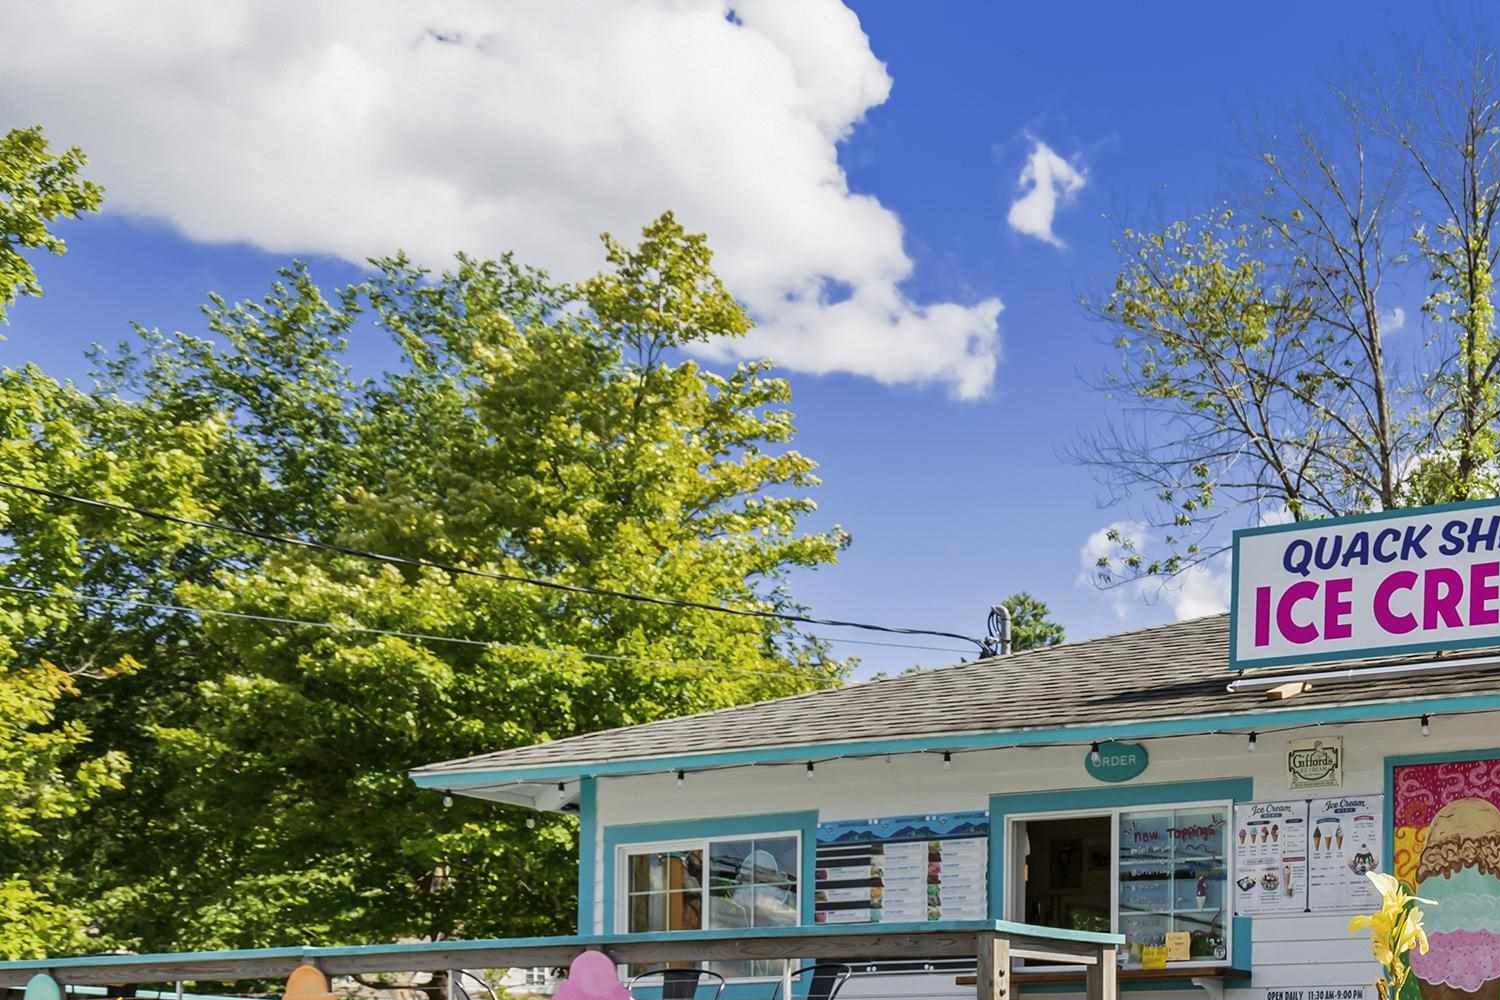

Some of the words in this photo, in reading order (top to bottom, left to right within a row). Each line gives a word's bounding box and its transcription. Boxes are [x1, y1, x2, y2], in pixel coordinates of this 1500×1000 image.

[1283, 523, 1432, 578] QUACK
[1255, 577, 1354, 647] ICE
[1267, 991, 1283, 1000] OPEN
[1285, 990, 1303, 1000] DAILY
[1353, 989, 1363, 999] PM
